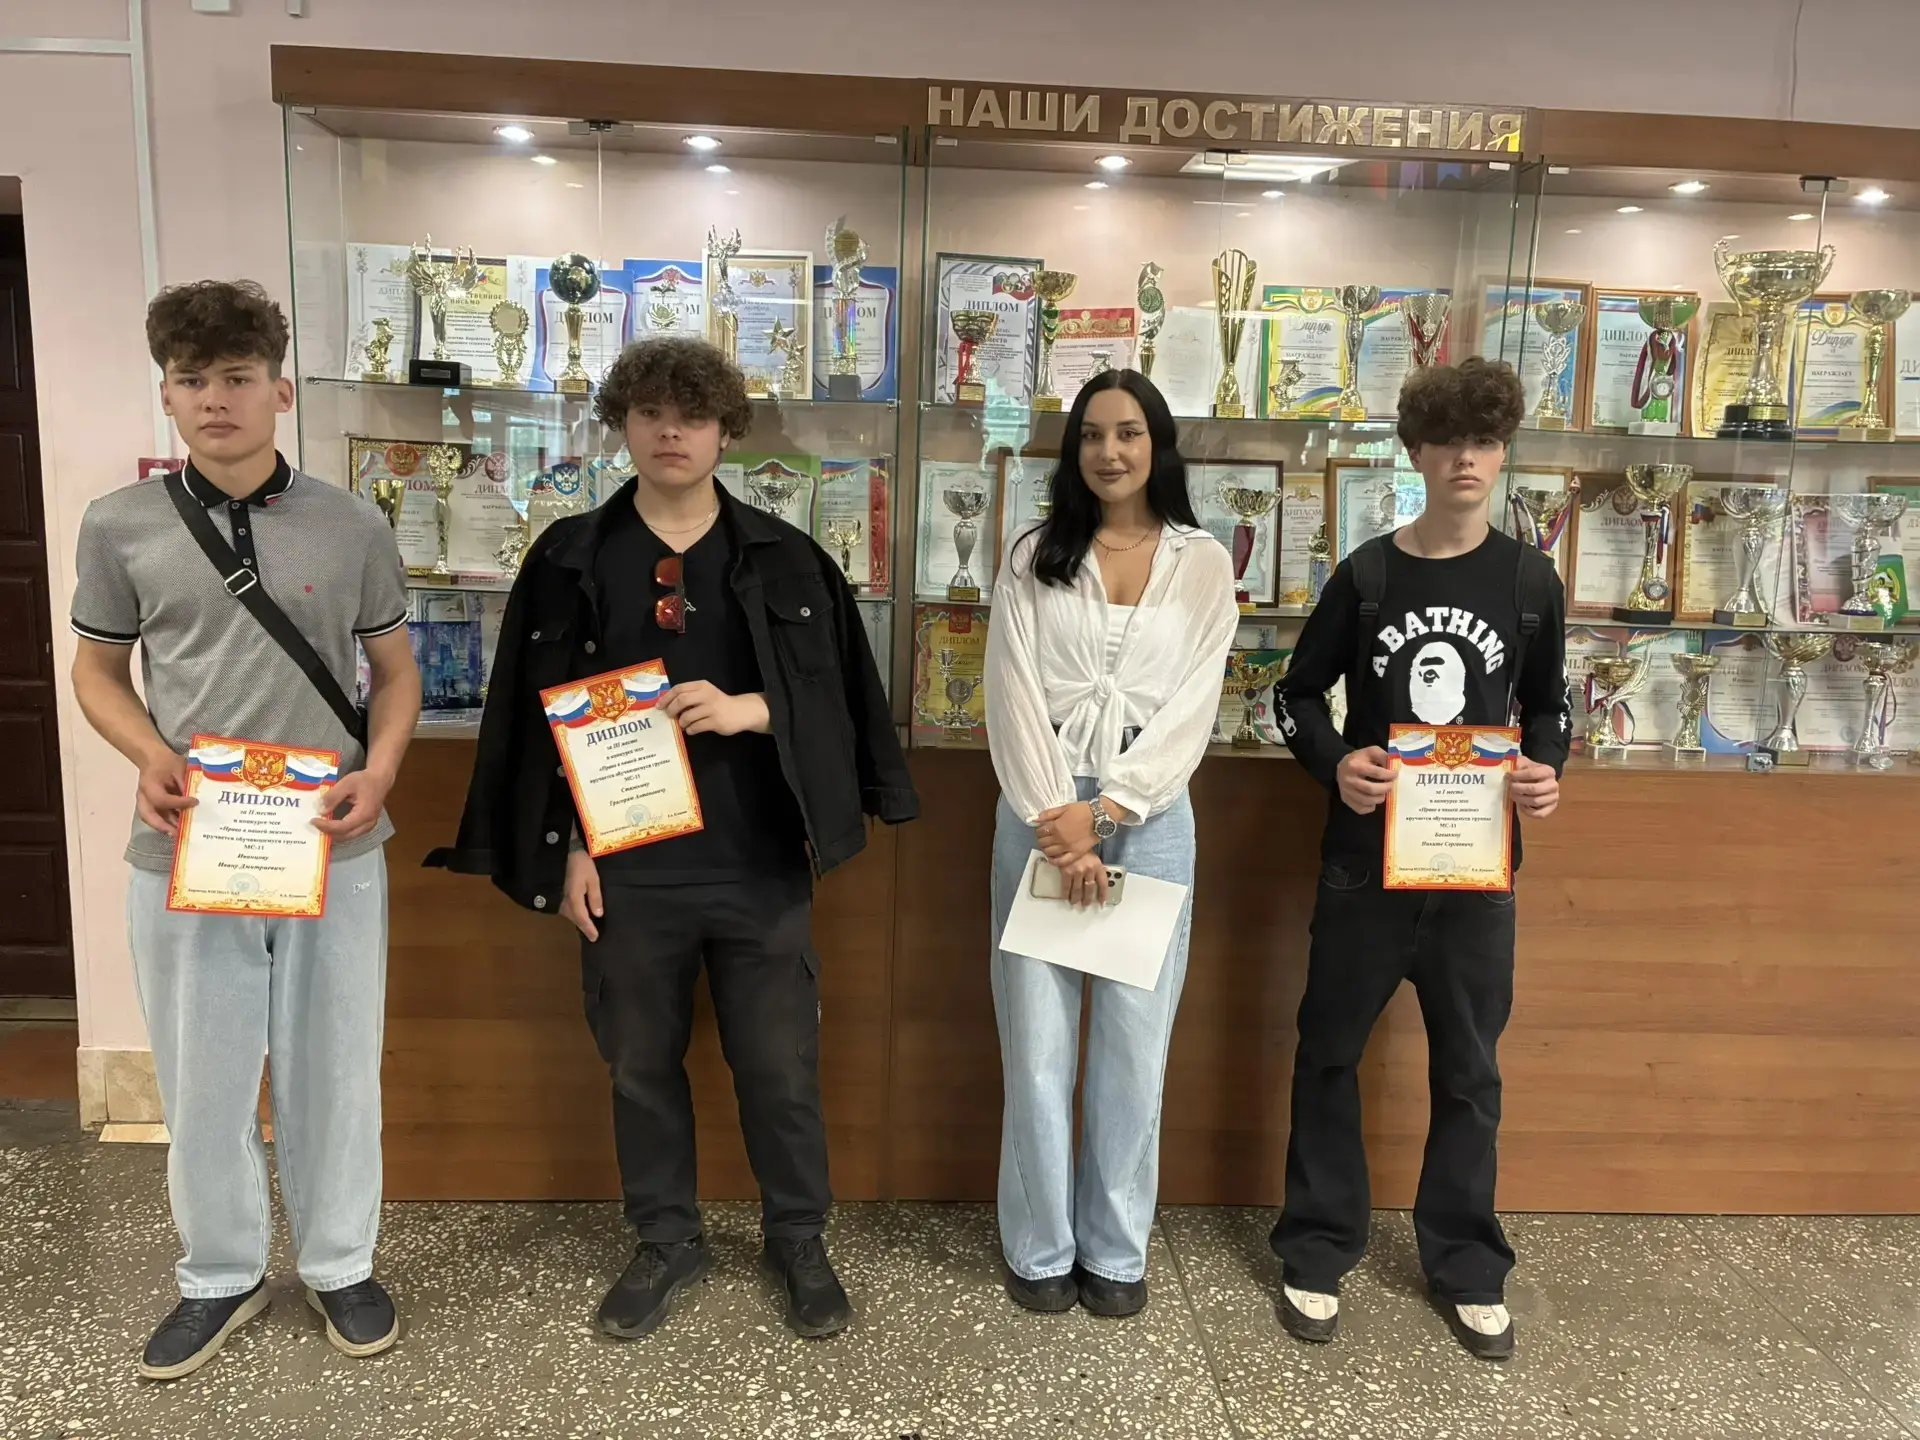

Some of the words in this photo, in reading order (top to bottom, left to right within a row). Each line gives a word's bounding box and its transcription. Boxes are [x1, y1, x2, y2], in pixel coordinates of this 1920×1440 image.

[927, 86, 1100, 133] НАШИ
[1120, 97, 1524, 152] ДОСТИЖЕНИЯ
[963, 300, 1019, 313] ДИПЛОМ
[555, 311, 613, 325] ДЛОМ
[939, 636, 980, 645] ДИПЛОМ
[1377, 606, 1505, 675] BATHING
[1372, 655, 1389, 678] A
[586, 717, 653, 747] ДИПЛОМ
[1415, 773, 1486, 786] ДИПЛОМ
[218, 790, 300, 808] ДИПЛОМ
[217, 861, 239, 869] Ивану
